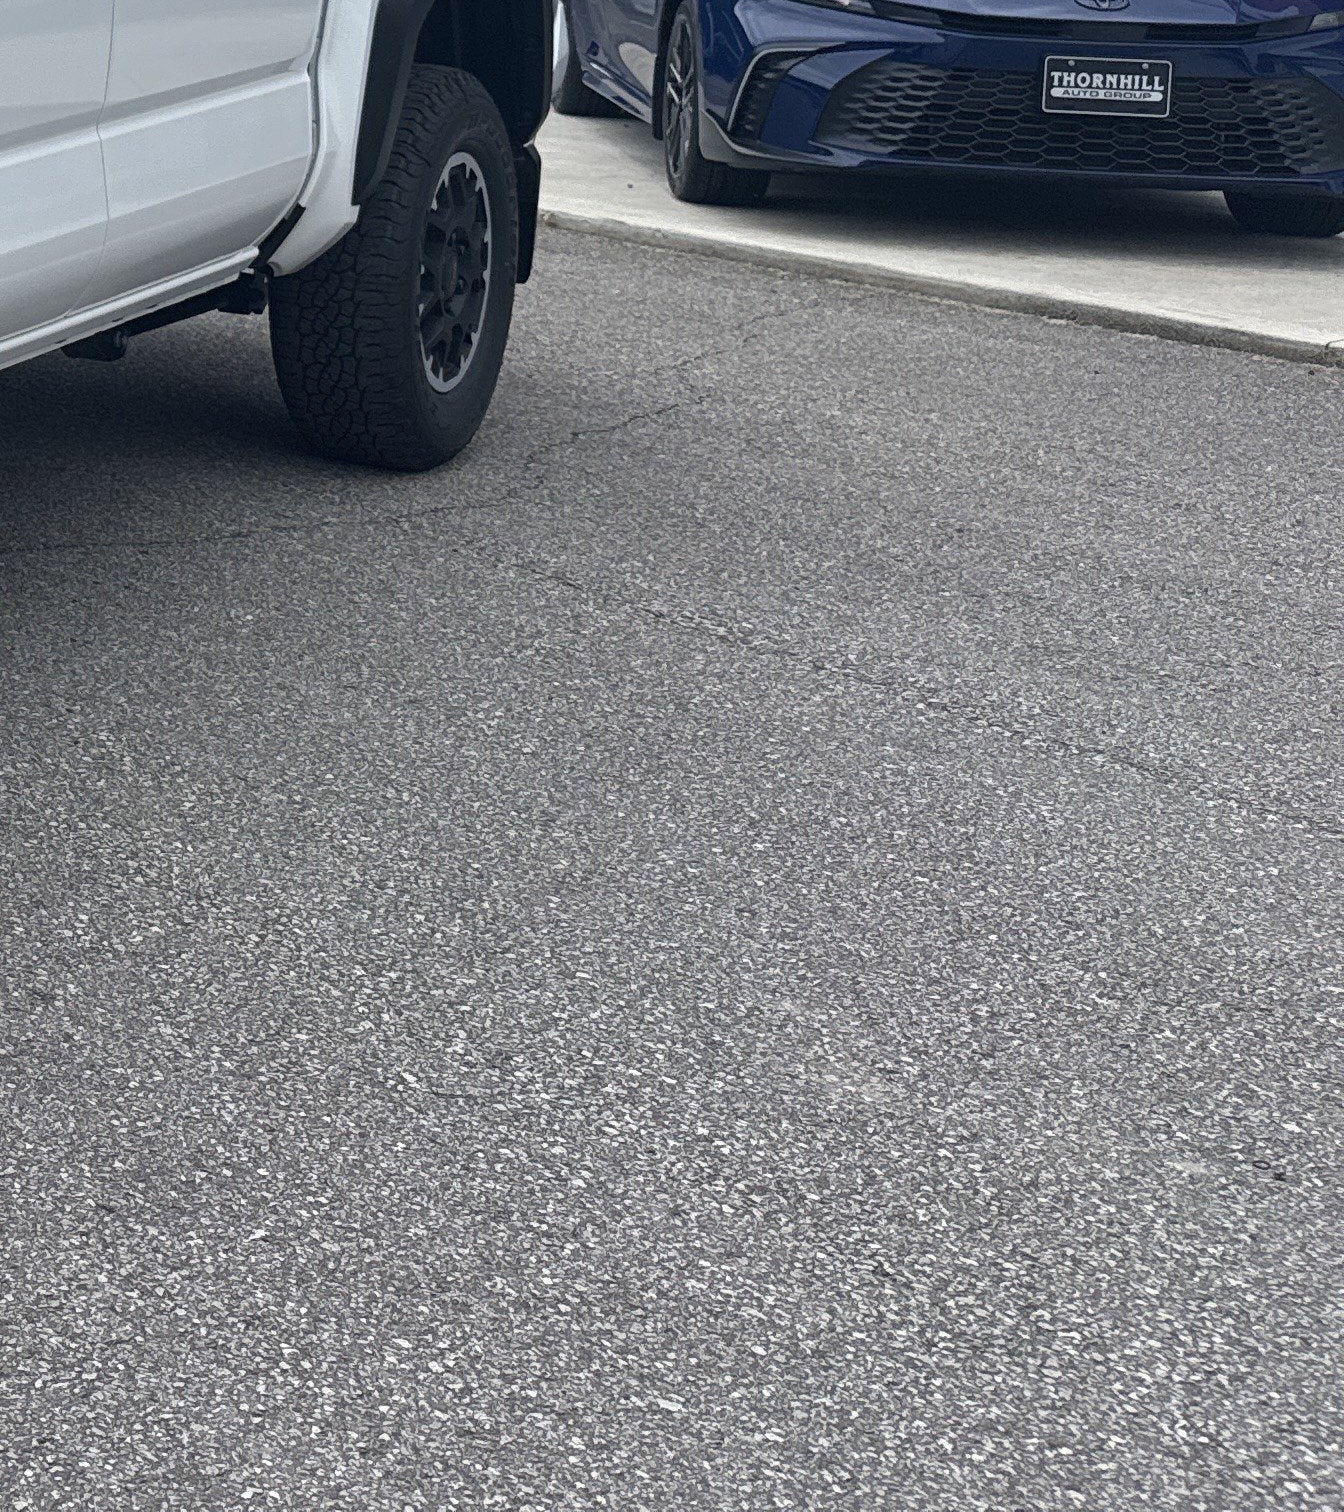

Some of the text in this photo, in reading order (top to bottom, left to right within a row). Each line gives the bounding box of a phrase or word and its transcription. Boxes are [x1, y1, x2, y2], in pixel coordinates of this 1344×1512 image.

[1050, 71, 1164, 90] THORNHILL
[1062, 89, 1153, 100] AUTO GROUP
